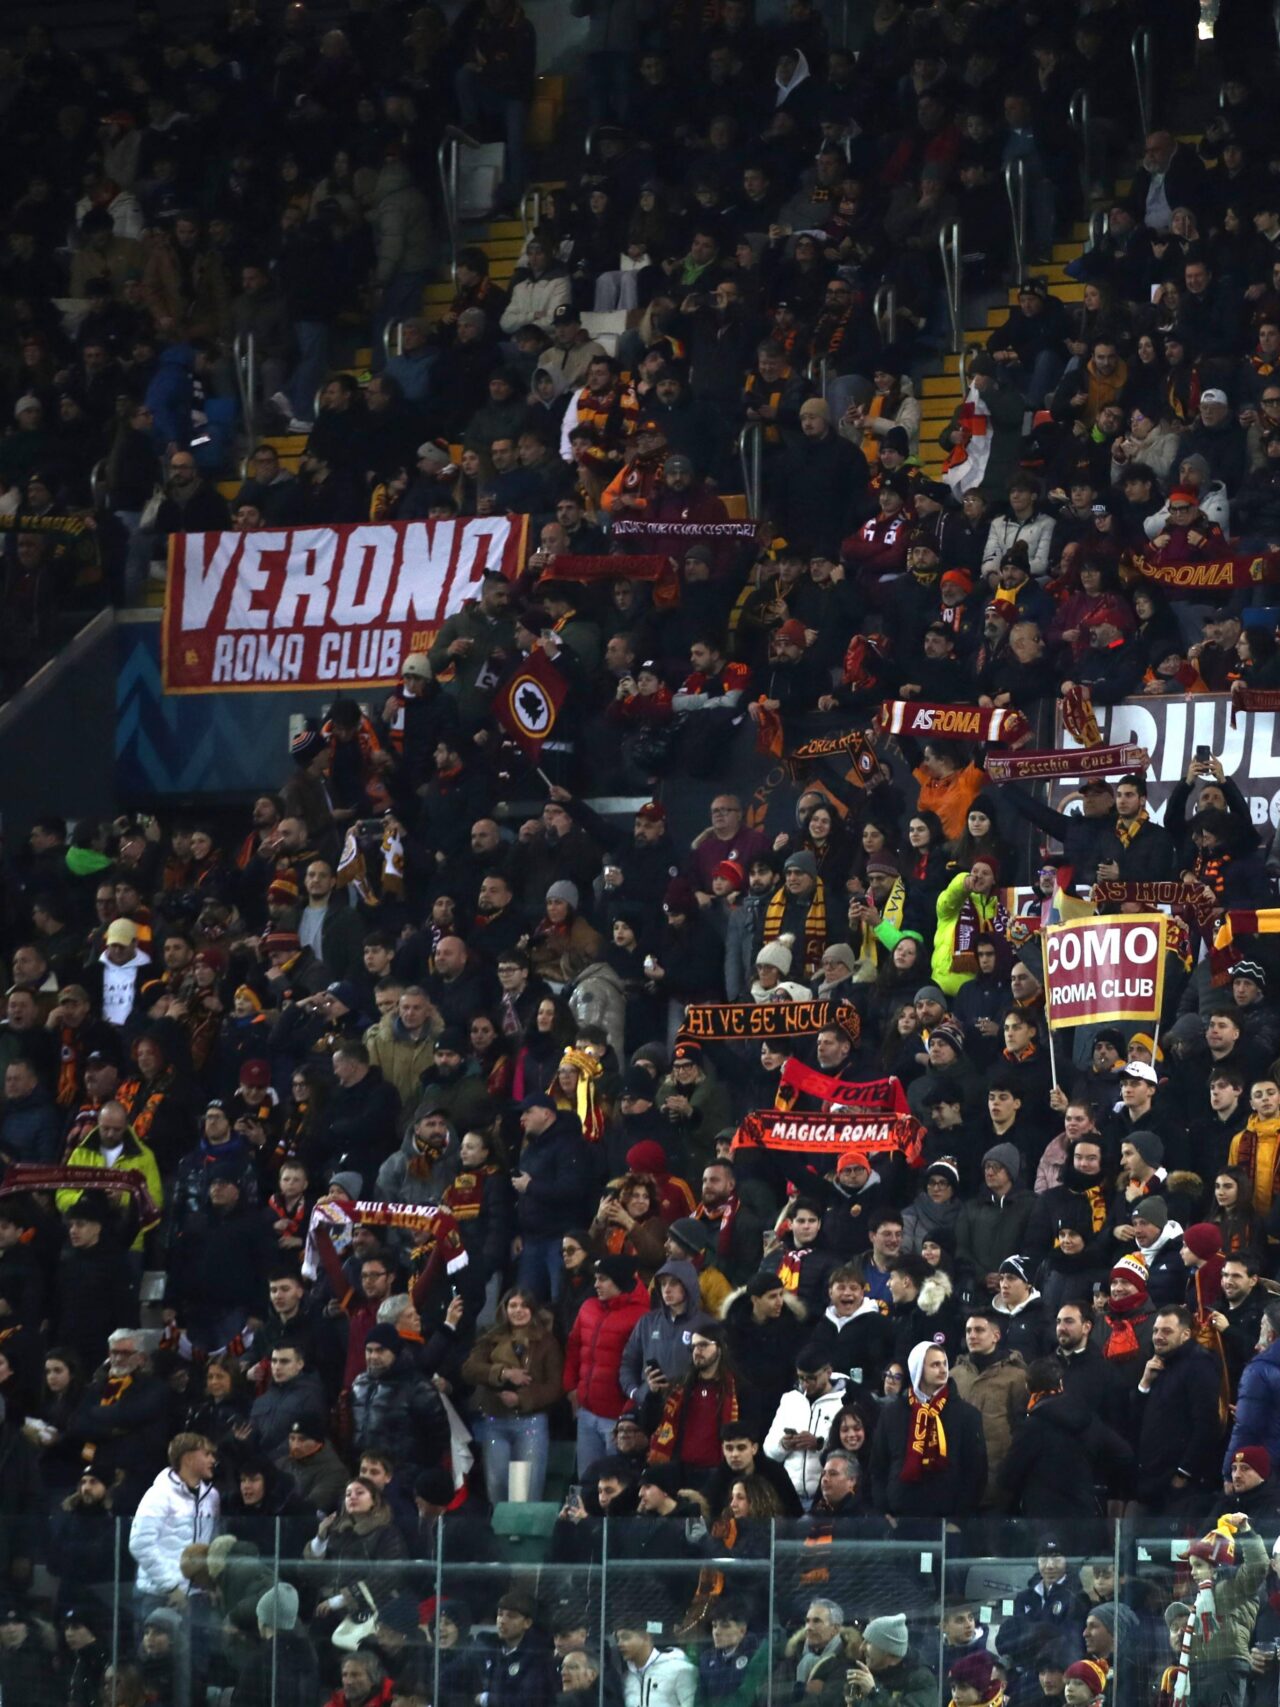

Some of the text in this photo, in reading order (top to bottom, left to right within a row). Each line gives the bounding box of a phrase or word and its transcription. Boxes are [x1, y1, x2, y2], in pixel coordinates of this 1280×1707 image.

[182, 516, 512, 631] VERONA
[212, 629, 402, 682] ROMA CLUB
[1136, 881, 1205, 904] ROM
[1047, 926, 1158, 975] COMO
[1053, 978, 1153, 1006] ROMA CLUB
[679, 1009, 715, 1034] HI
[720, 1008, 745, 1034] VE
[751, 1006, 776, 1033] SE
[771, 1122, 890, 1142] MAGICA ROMA
